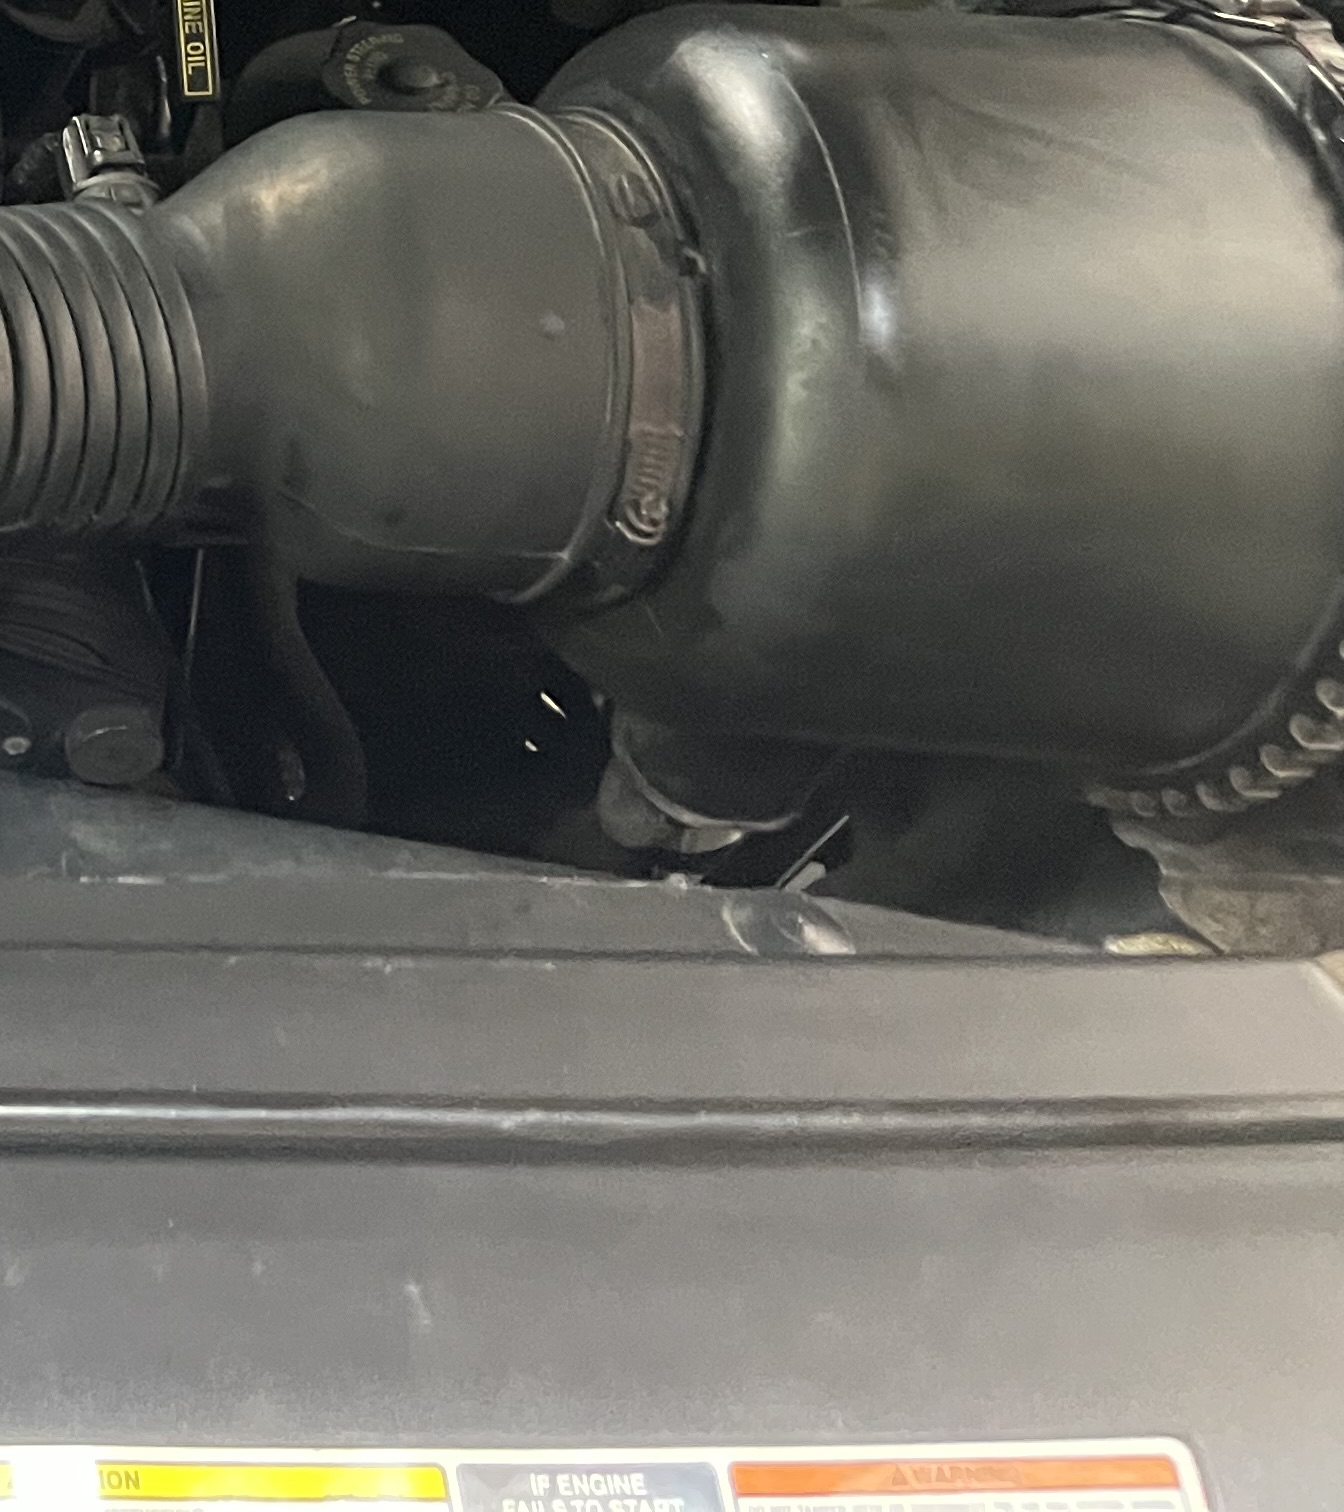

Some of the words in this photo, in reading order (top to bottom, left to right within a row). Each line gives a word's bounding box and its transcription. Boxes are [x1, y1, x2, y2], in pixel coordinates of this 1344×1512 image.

[186, 41, 207, 76] OIL
[530, 1473, 550, 1496] IF
[556, 1473, 648, 1496] ENGINE
